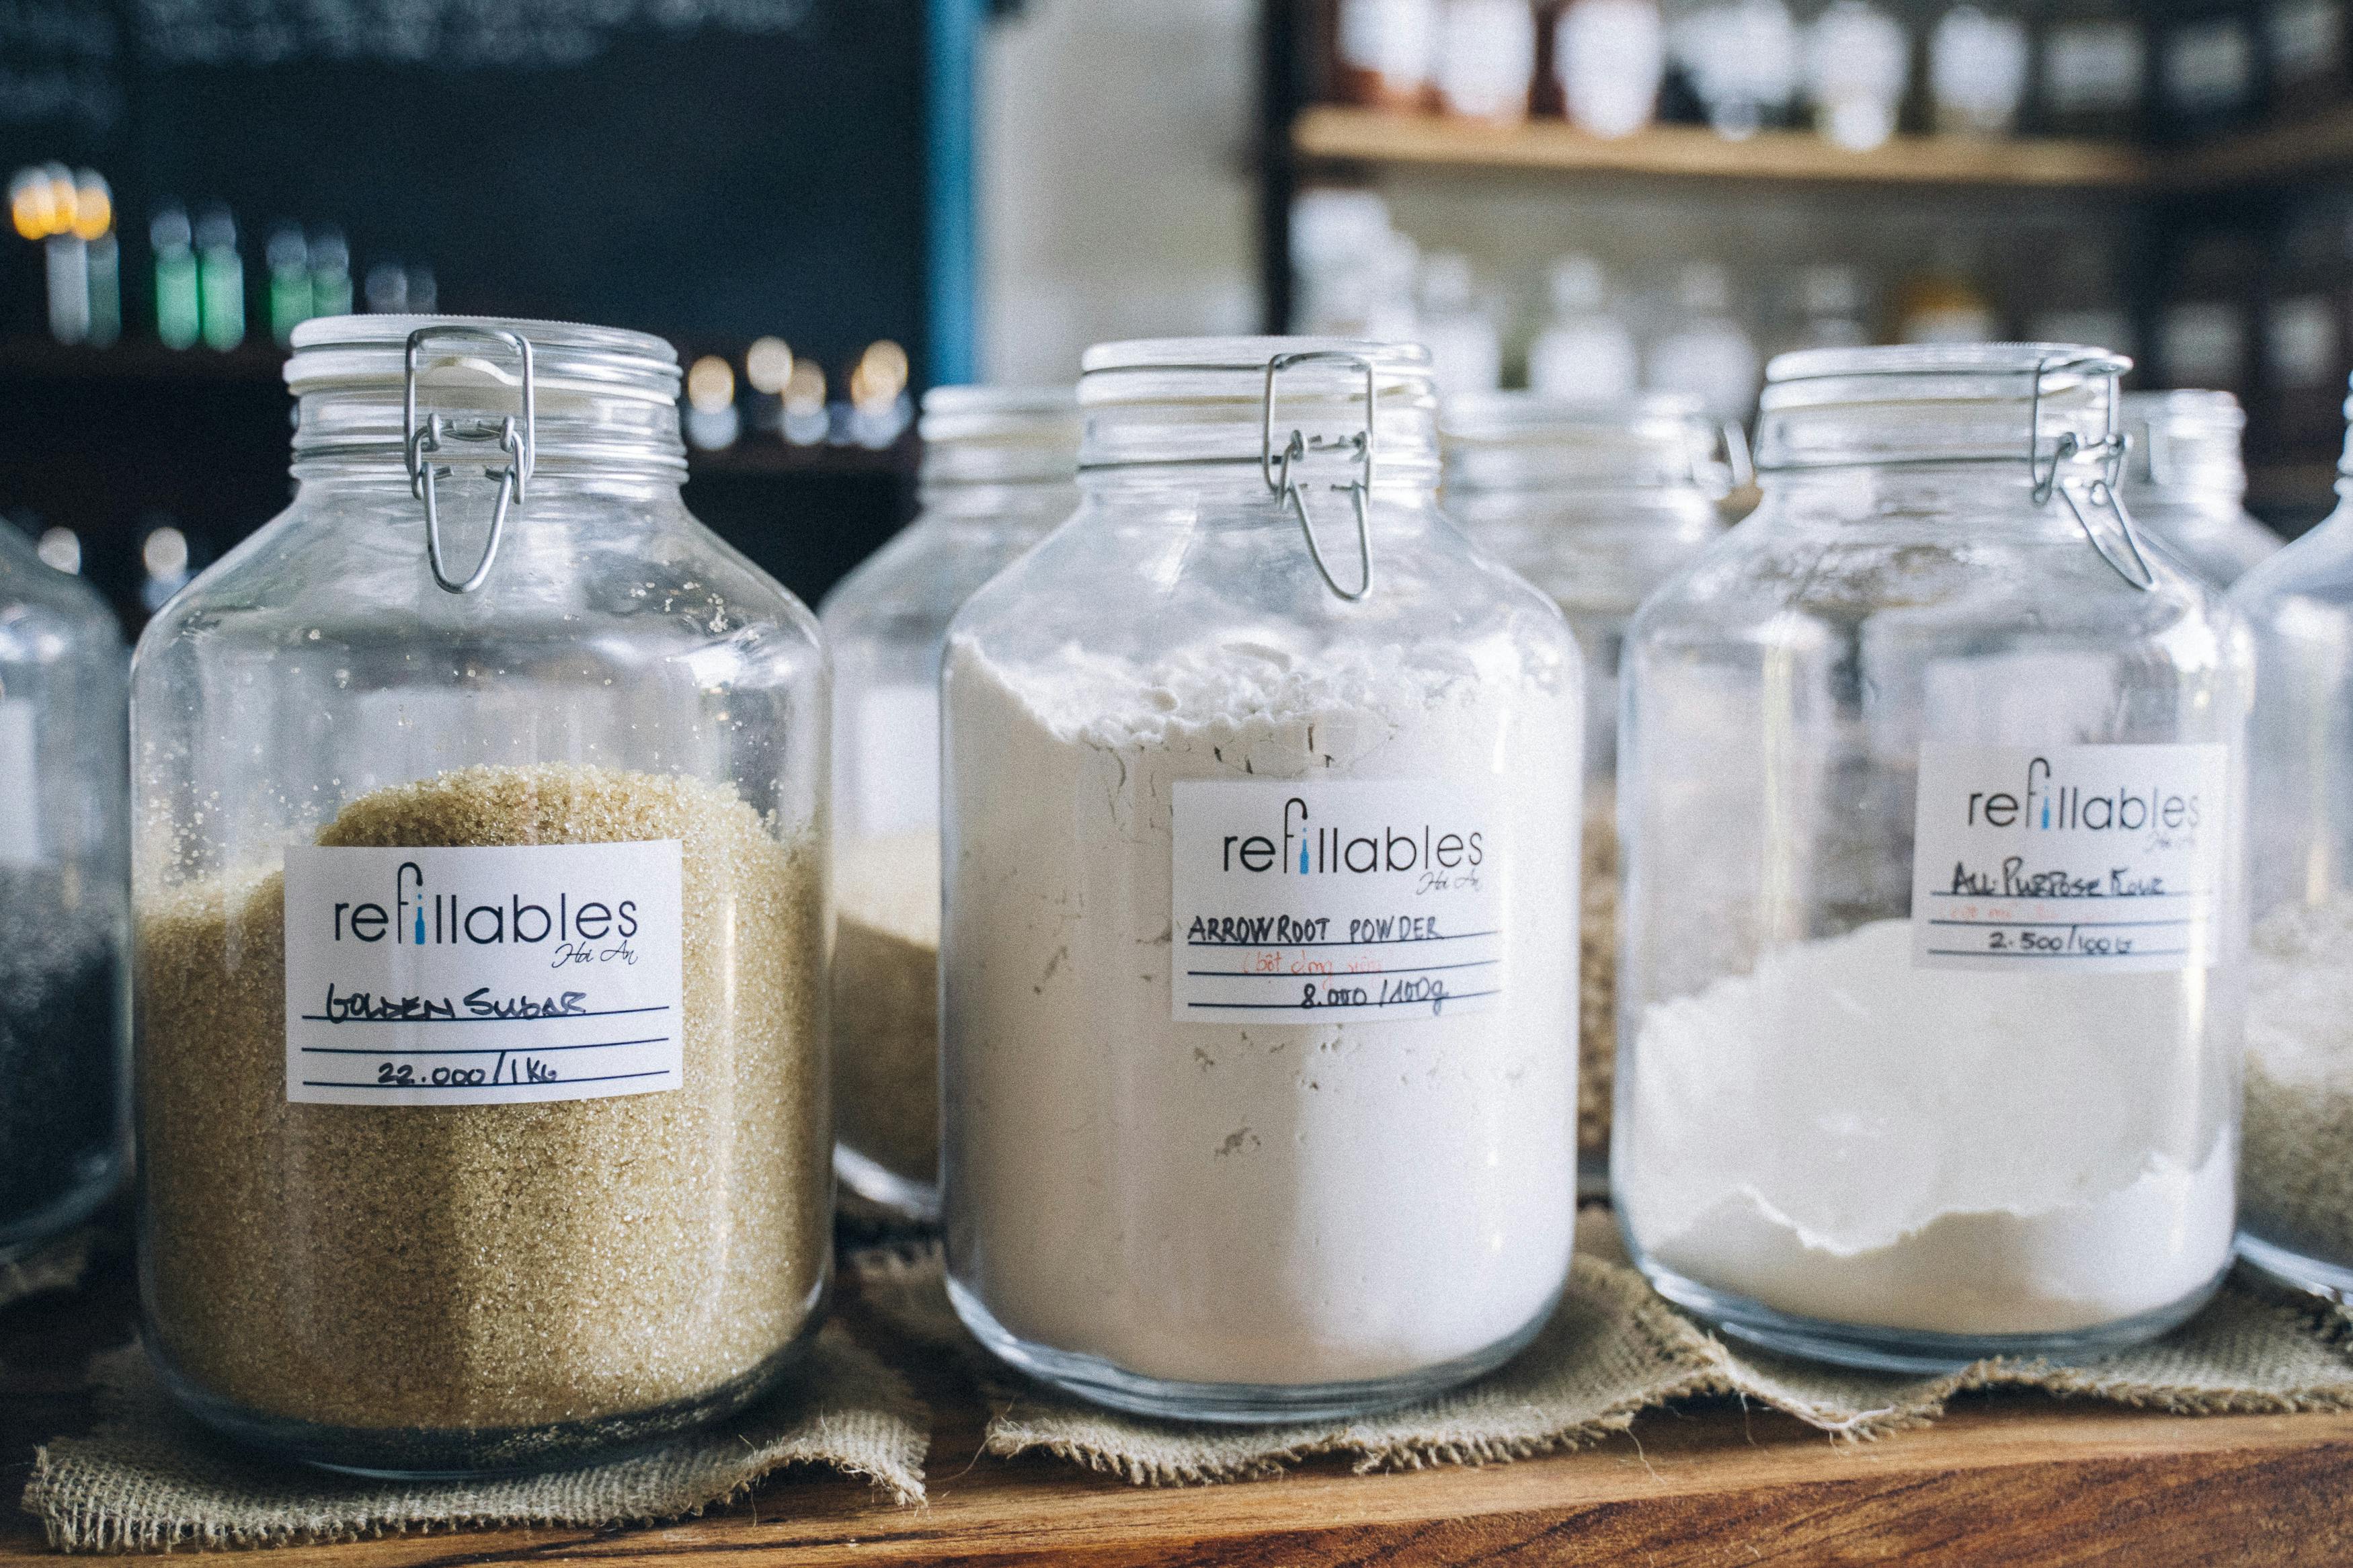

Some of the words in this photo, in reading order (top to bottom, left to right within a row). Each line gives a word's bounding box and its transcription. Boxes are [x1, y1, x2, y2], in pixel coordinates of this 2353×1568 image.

[1968, 757, 2200, 830] refillables
[1223, 798, 1482, 875] refillables
[334, 862, 638, 945] refillables
[1350, 916, 1443, 942] POWDER
